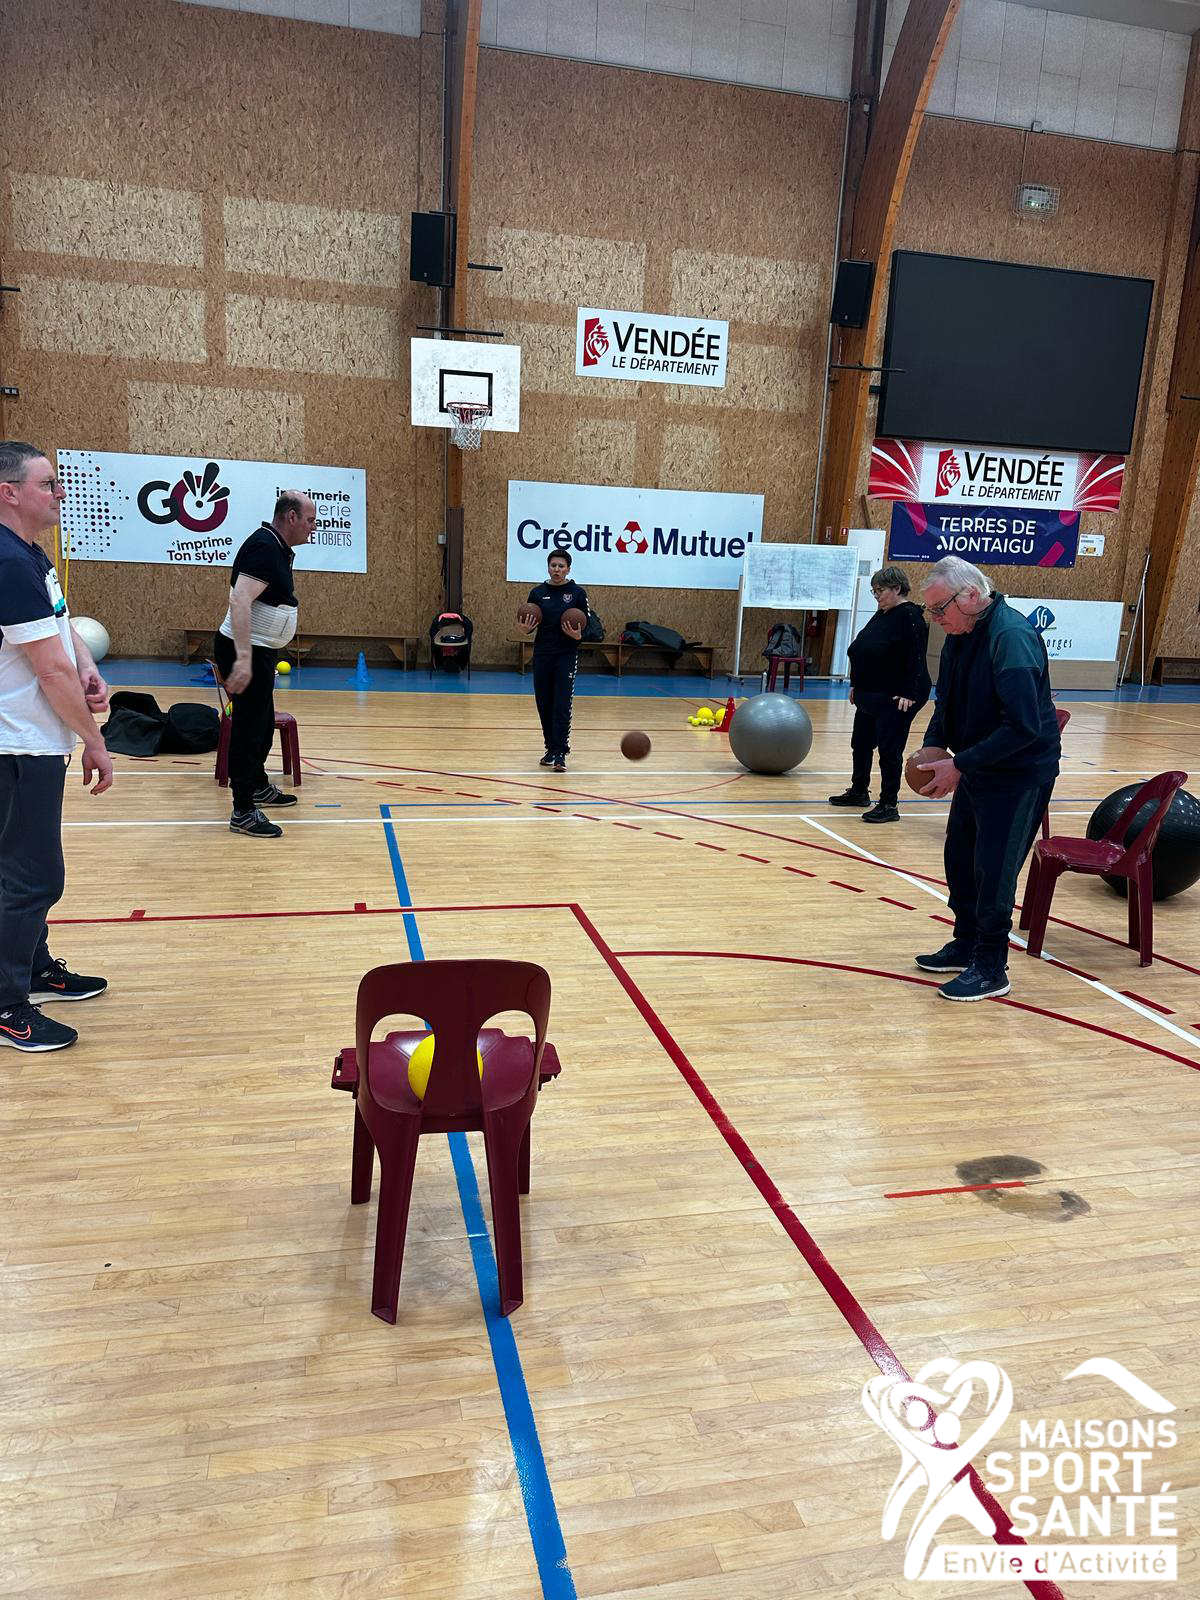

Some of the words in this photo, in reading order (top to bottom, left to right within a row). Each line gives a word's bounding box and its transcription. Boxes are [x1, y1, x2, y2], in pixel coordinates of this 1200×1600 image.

[613, 321, 721, 361] VENDÉE
[612, 355, 626, 369] LE
[630, 355, 719, 376] DÉPARTEMENT
[964, 451, 1065, 487] VENDÉE
[961, 484, 974, 498] LE
[978, 484, 1061, 502] DÉPARTEMENT
[517, 519, 613, 553] Crédit
[939, 516, 1007, 535] TERRES
[1012, 520, 1036, 536] DE
[166, 550, 192, 561] Ton
[936, 535, 1035, 555] MONTAIGU
[1035, 607, 1048, 629] SG
